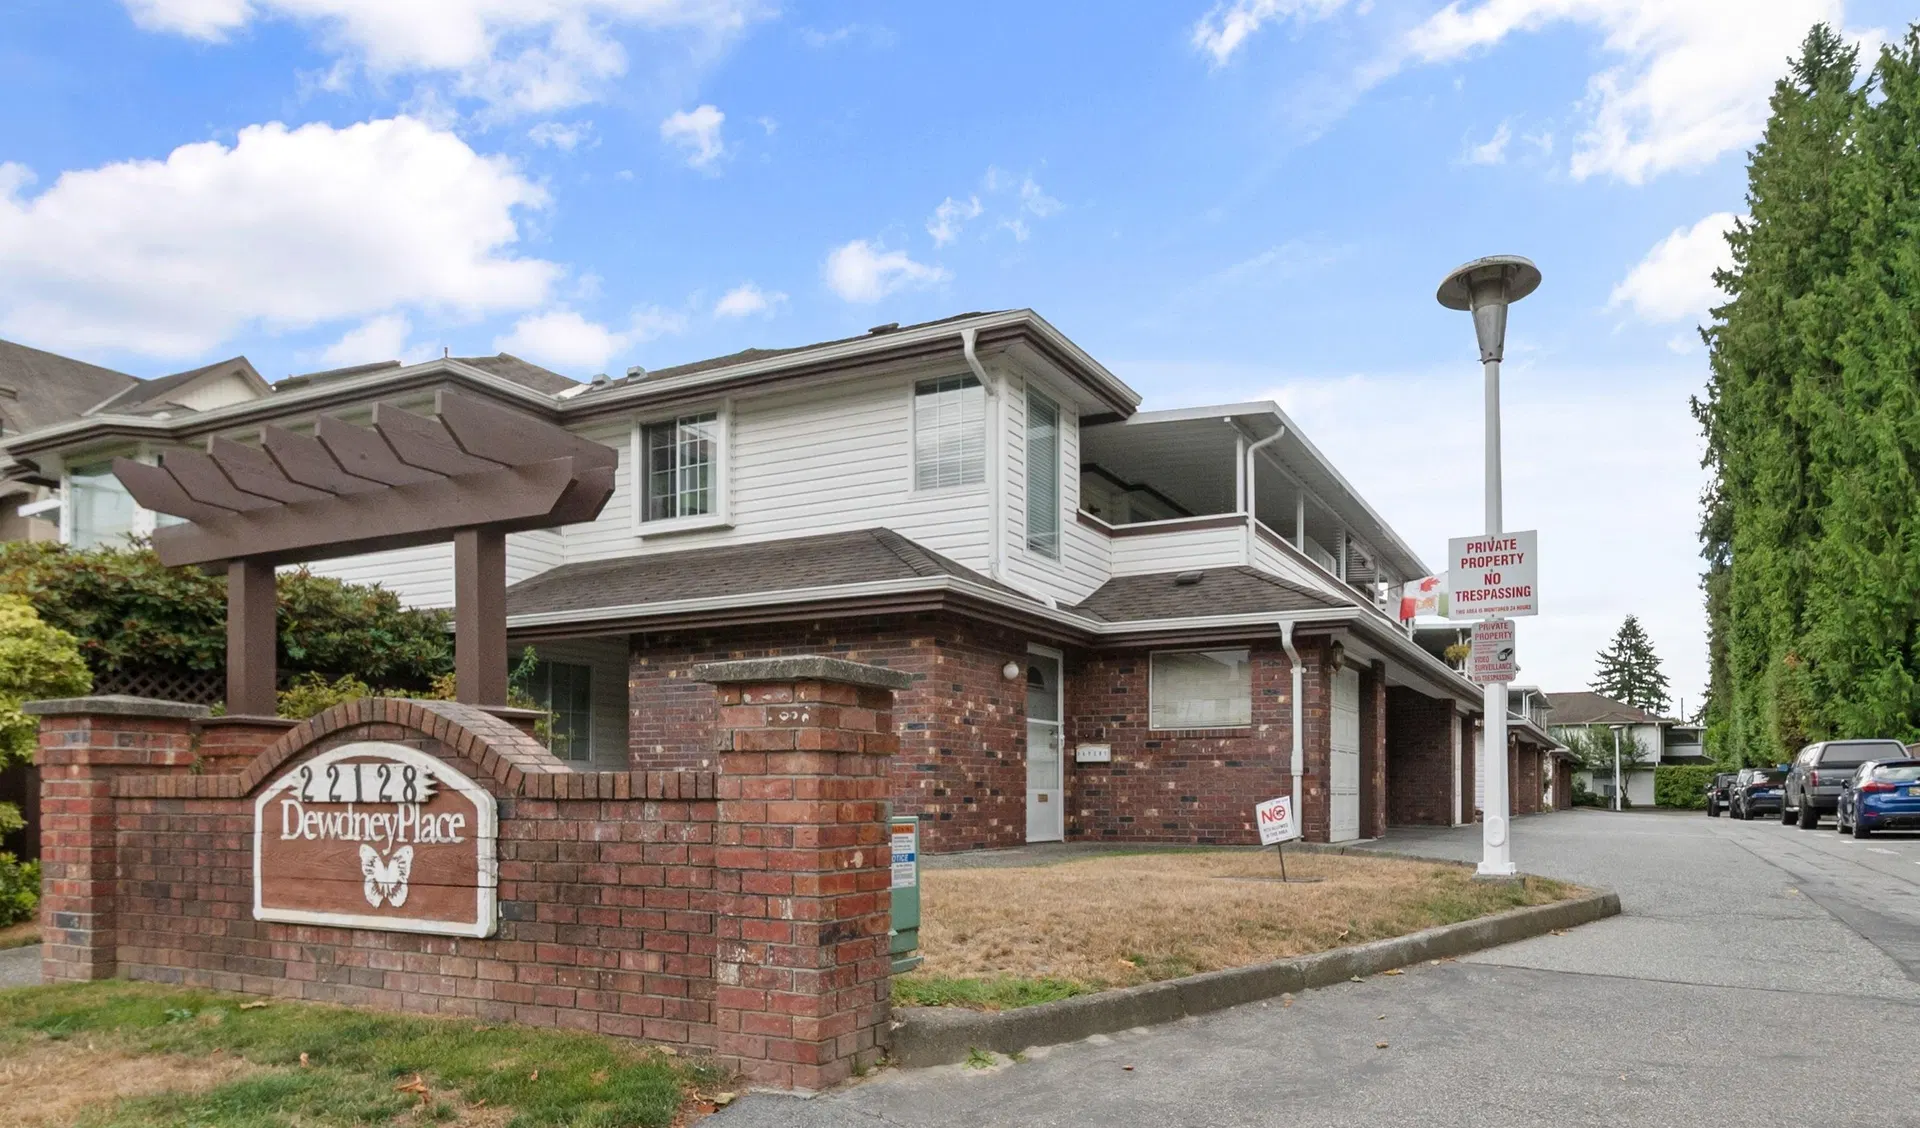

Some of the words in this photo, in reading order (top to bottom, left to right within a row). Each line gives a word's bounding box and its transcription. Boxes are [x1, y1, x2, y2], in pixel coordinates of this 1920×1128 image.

[1467, 538, 1517, 554] PRIVATE
[1461, 553, 1524, 569] PROPERTY
[1484, 572, 1501, 585] NO
[1456, 586, 1531, 602] TRESPASSING
[1479, 622, 1508, 630] PRIVATE
[1475, 632, 1512, 640] PROPERTY
[1475, 663, 1512, 671] SURVEILLANCE
[300, 764, 417, 802] 22128
